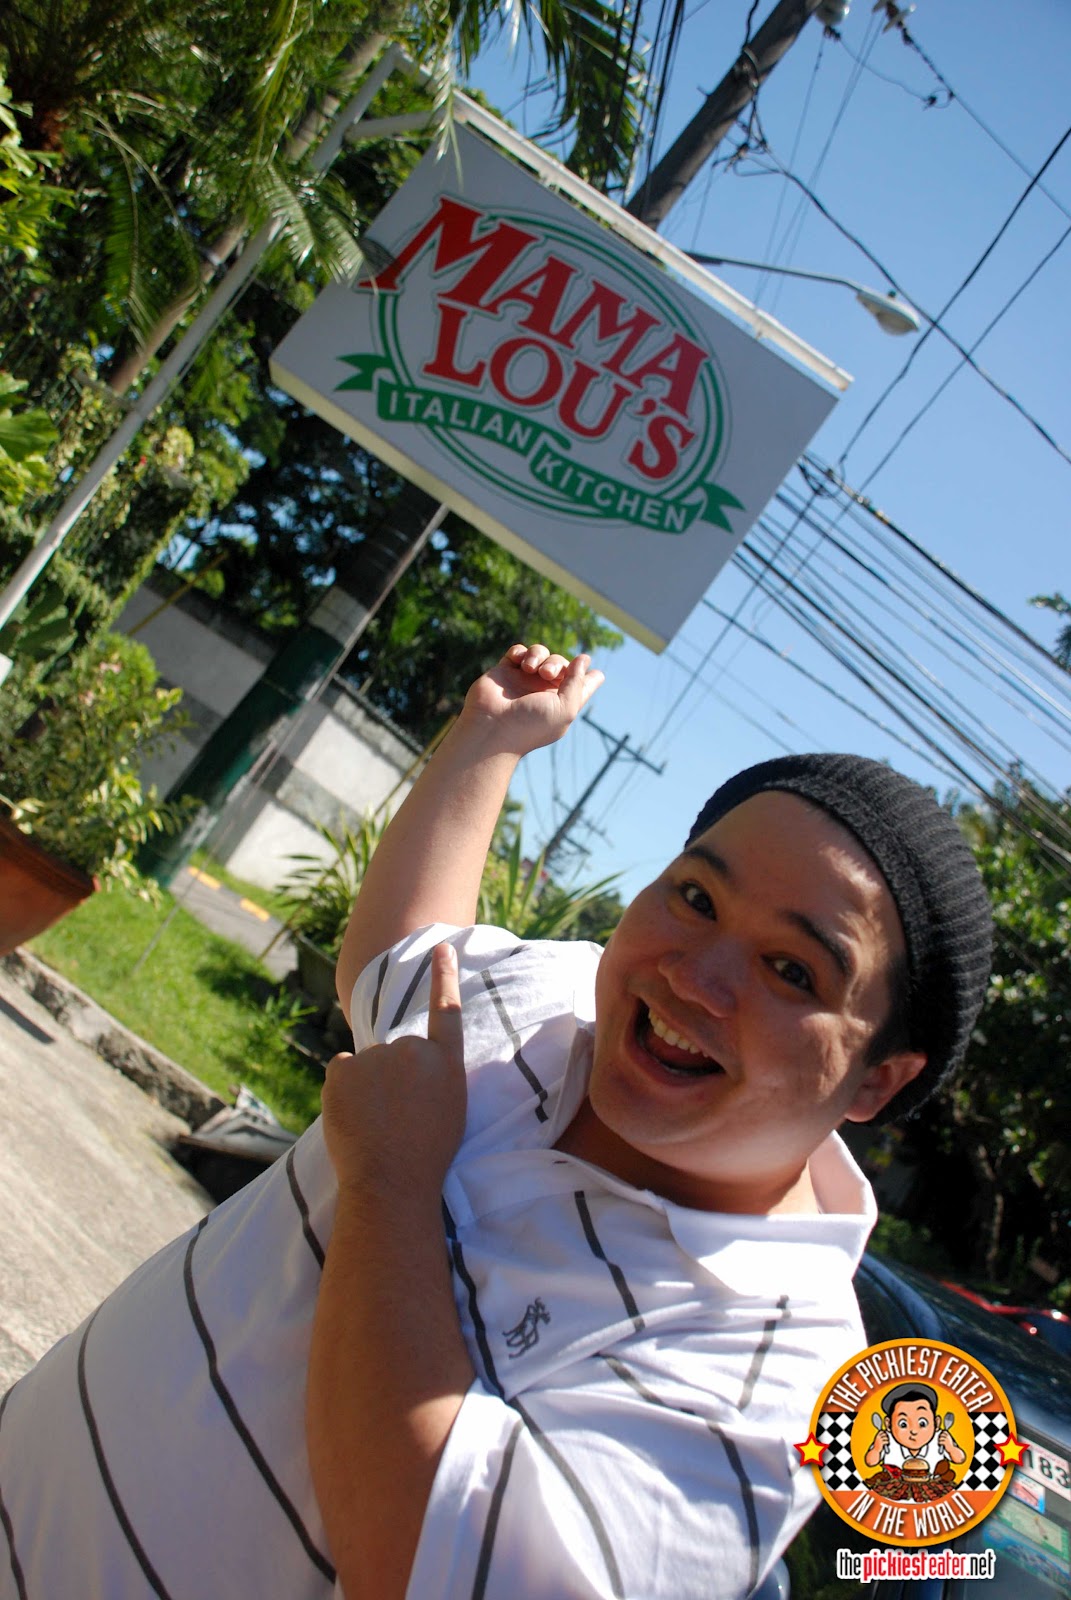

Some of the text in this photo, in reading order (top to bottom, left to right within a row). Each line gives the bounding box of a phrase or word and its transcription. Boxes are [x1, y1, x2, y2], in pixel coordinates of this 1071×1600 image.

[357, 196, 709, 418] MAMA
[423, 303, 696, 479] LOU'S
[389, 390, 687, 531] ITALIAN KITCHEN
